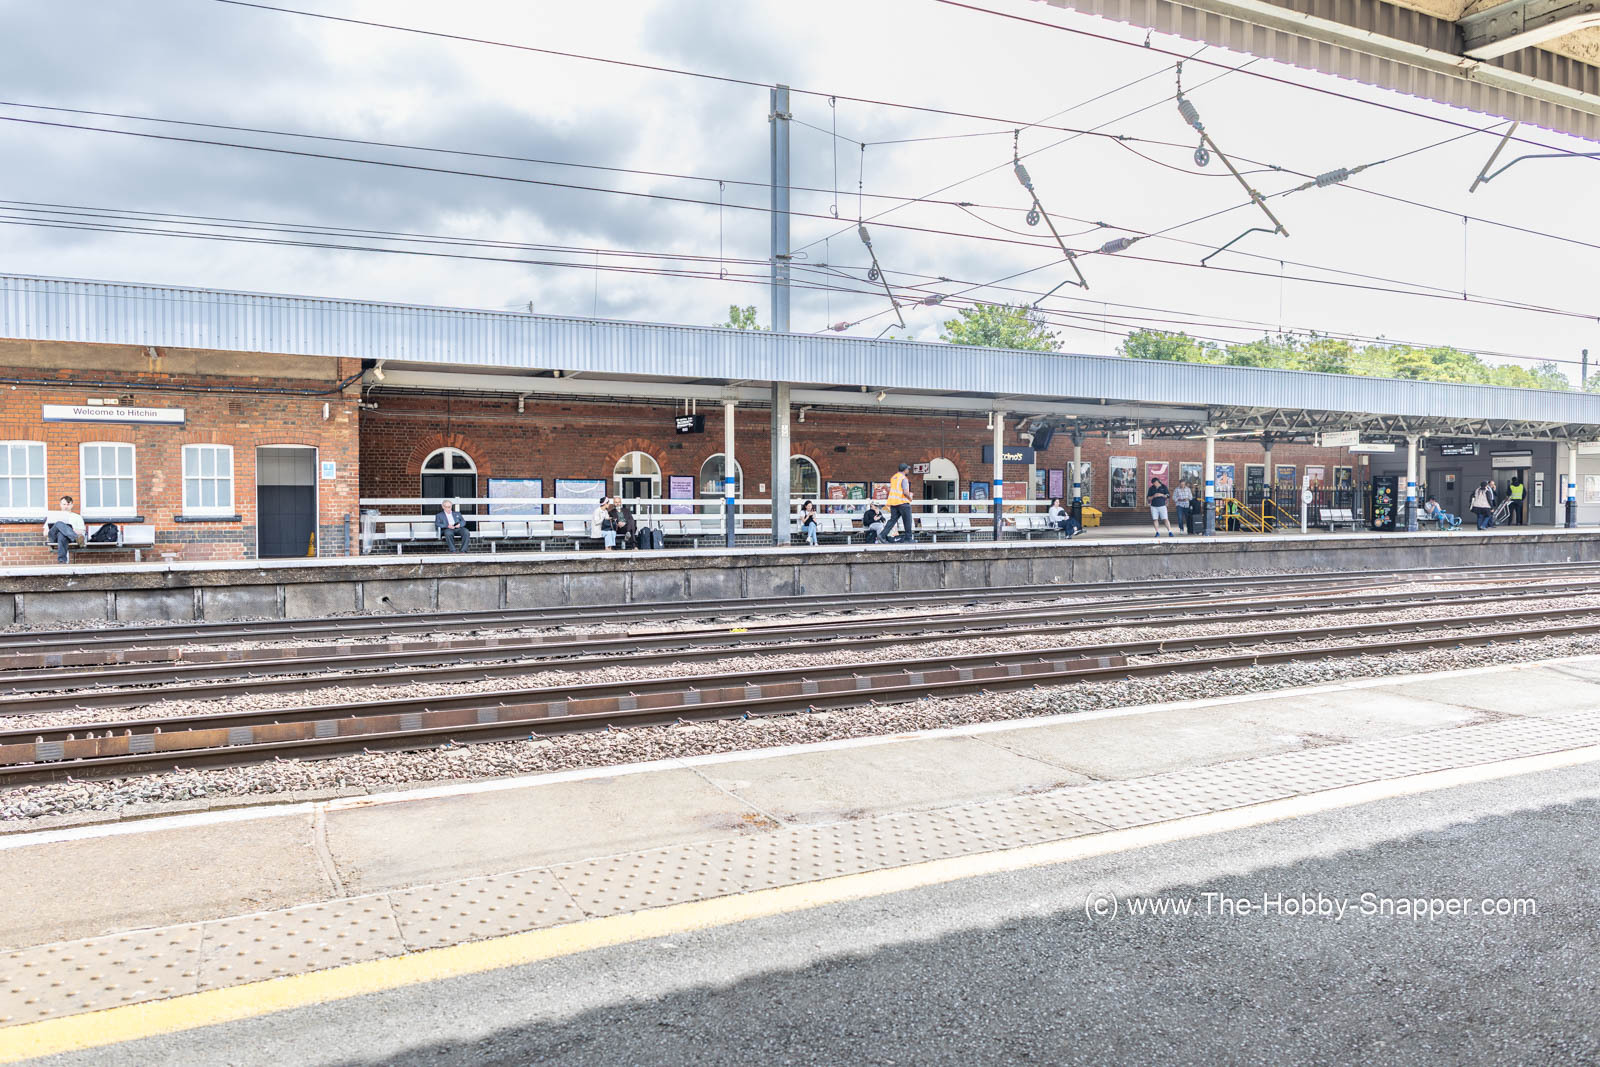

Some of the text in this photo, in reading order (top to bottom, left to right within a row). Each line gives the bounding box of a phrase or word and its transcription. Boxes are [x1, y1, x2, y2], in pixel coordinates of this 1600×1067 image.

[73, 408, 114, 416] Welcome
[127, 409, 158, 417] Hitchin
[1131, 433, 1135, 443] 1
